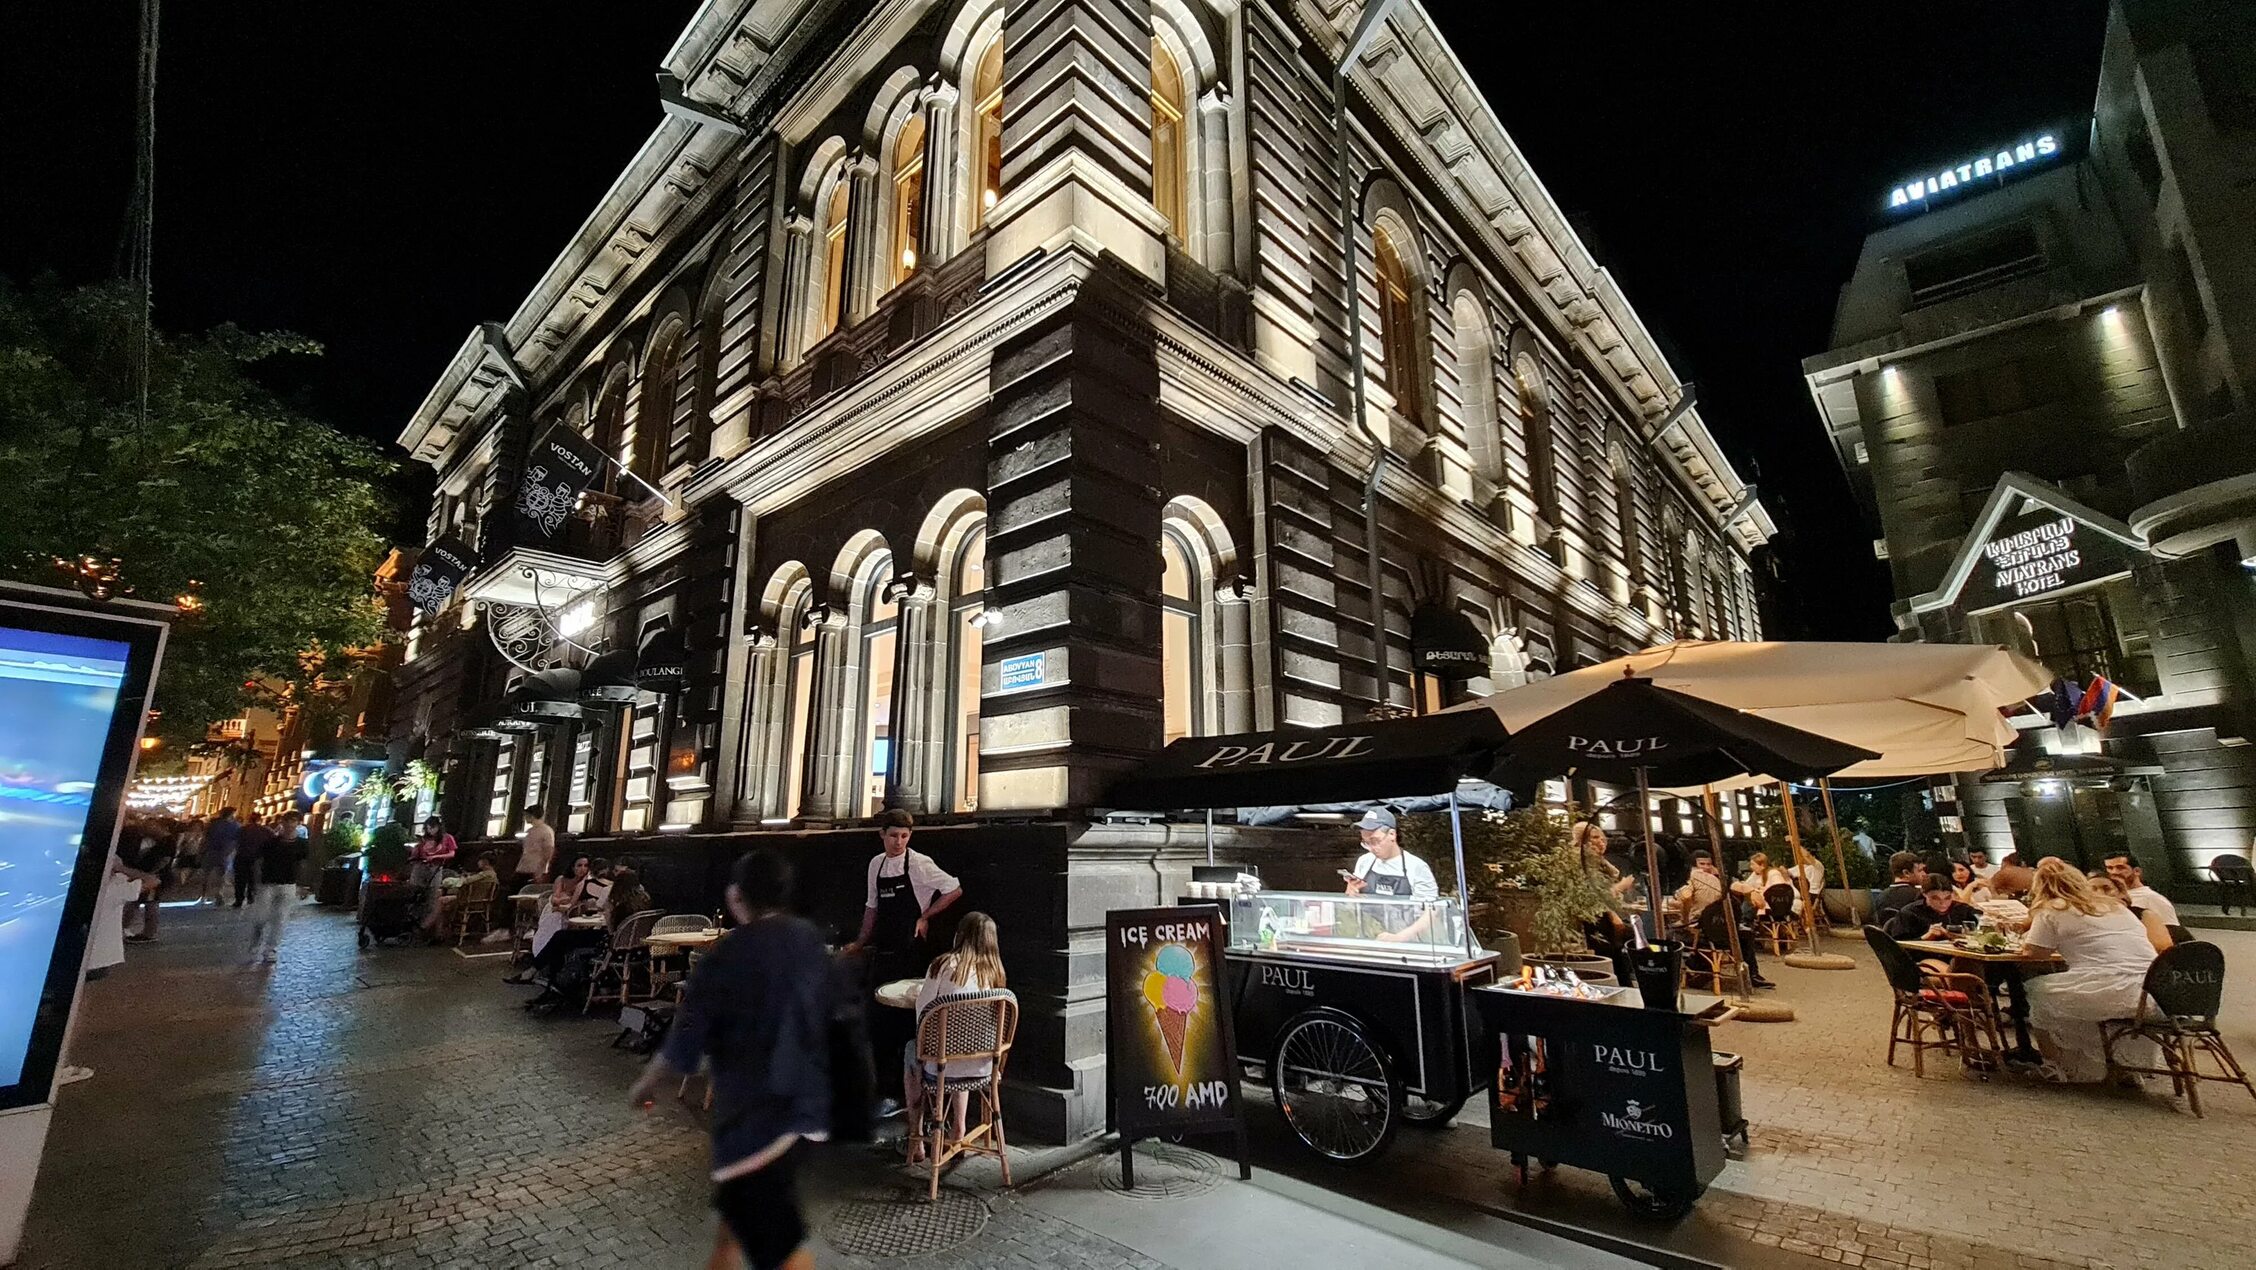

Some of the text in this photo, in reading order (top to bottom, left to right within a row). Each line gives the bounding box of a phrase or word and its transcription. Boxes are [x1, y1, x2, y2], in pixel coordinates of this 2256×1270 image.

[1889, 136, 2057, 207] AVIATRANS
[550, 442, 593, 476] VOSTAN
[434, 547, 468, 572] VOSTAN
[1996, 550, 2081, 588] AVIATRANS
[2016, 573, 2065, 597] HOTEL
[1003, 660, 1035, 674] ABOVYAN
[1035, 658, 1043, 680] 8
[1192, 735, 1375, 769] PAUL
[1567, 735, 1670, 753] PAUL
[1120, 922, 1211, 949] ICE CREAM
[1262, 965, 1315, 990] PAUL
[2171, 970, 2217, 985] PAUL
[1593, 1044, 1665, 1072] PAUL
[1144, 1080, 1229, 1111] 700 AMD
